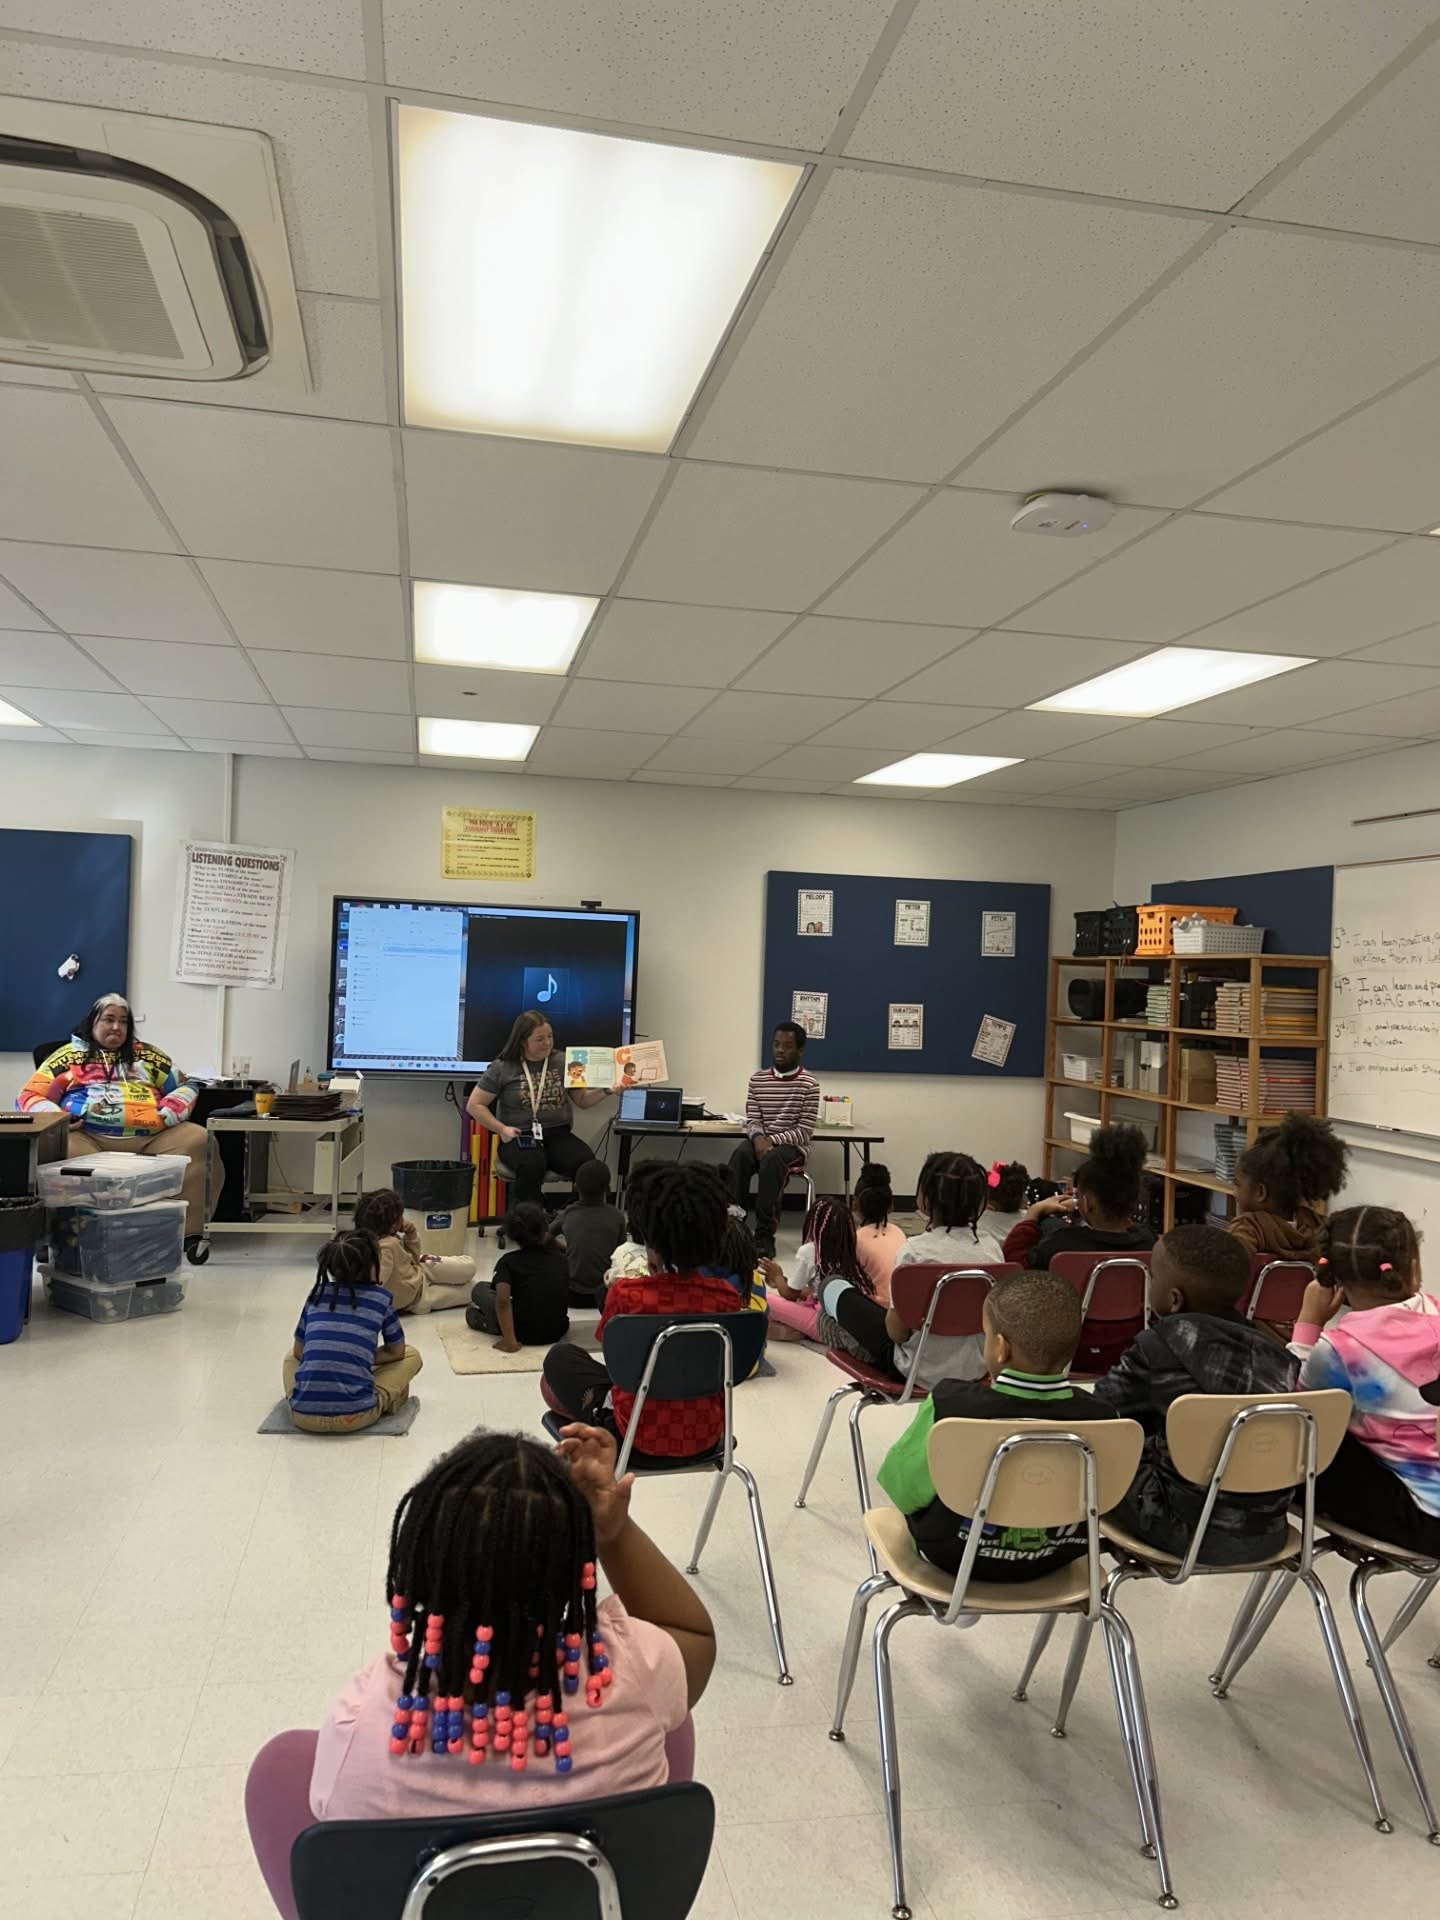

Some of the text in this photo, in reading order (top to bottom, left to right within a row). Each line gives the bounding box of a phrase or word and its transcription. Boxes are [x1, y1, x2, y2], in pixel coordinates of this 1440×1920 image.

[191, 852, 280, 872] LISTENING QUESTIONS
[1357, 977, 1370, 992] I
[1372, 984, 1388, 993] can
[1392, 976, 1413, 991] learn
[1414, 977, 1429, 991] and
[616, 1047, 631, 1065] C
[978, 1546, 1057, 1561] SURVIVE
